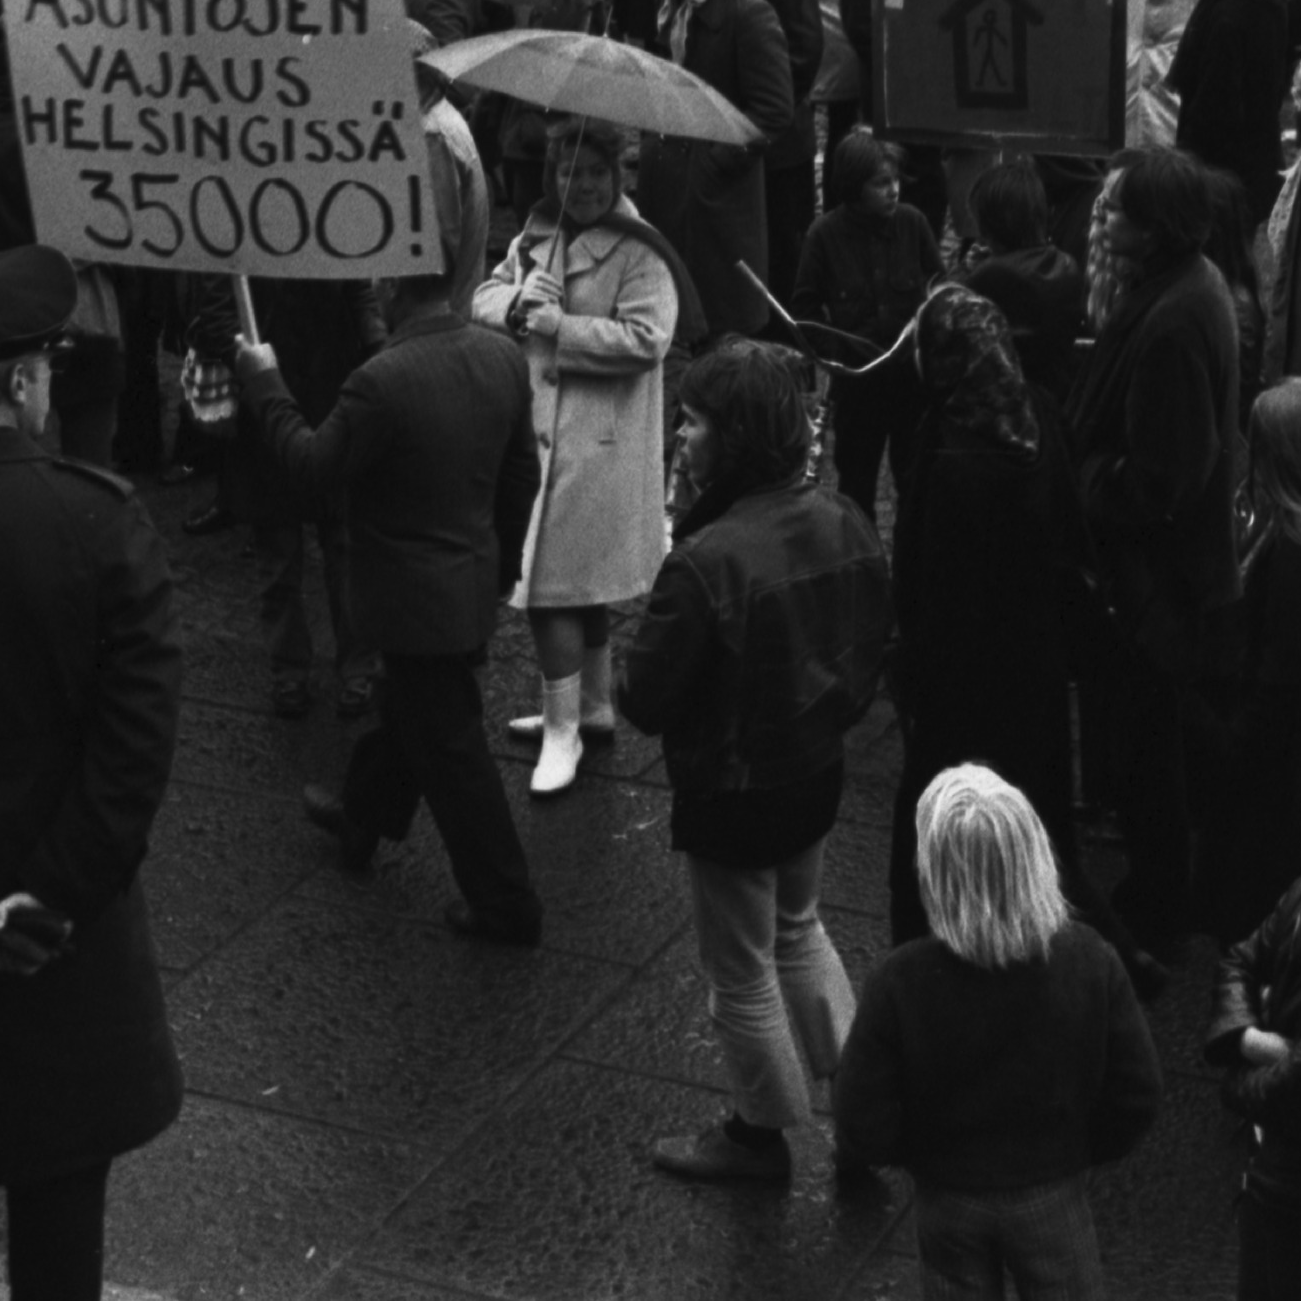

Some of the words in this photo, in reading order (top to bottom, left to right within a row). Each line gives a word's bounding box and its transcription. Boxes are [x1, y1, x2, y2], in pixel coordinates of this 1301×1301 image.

[56, 42, 312, 108] VAJAUS
[21, 95, 406, 168] HELSINGISSÄ
[78, 169, 423, 259] 35000!
